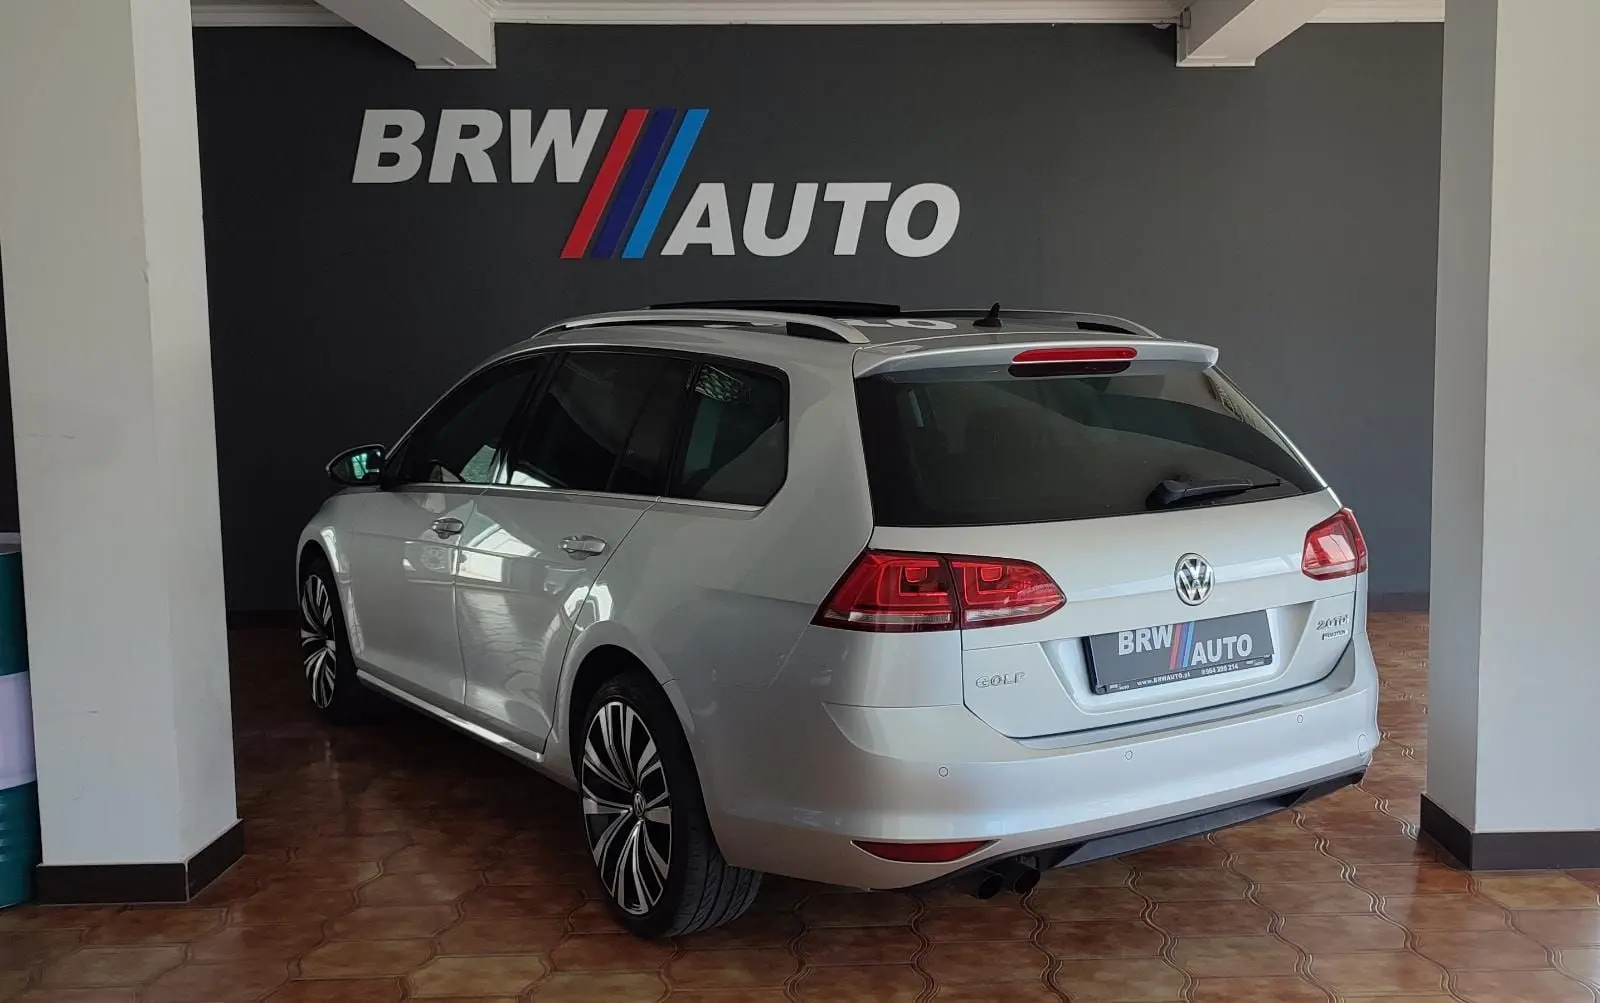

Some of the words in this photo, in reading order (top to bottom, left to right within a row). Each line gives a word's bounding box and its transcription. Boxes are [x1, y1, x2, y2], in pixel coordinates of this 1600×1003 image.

[352, 108, 608, 184] BRW
[660, 181, 961, 258] AUTO
[1118, 624, 1174, 656] BRW
[1191, 633, 1253, 666] AUTO
[975, 671, 1026, 689] GOLF
